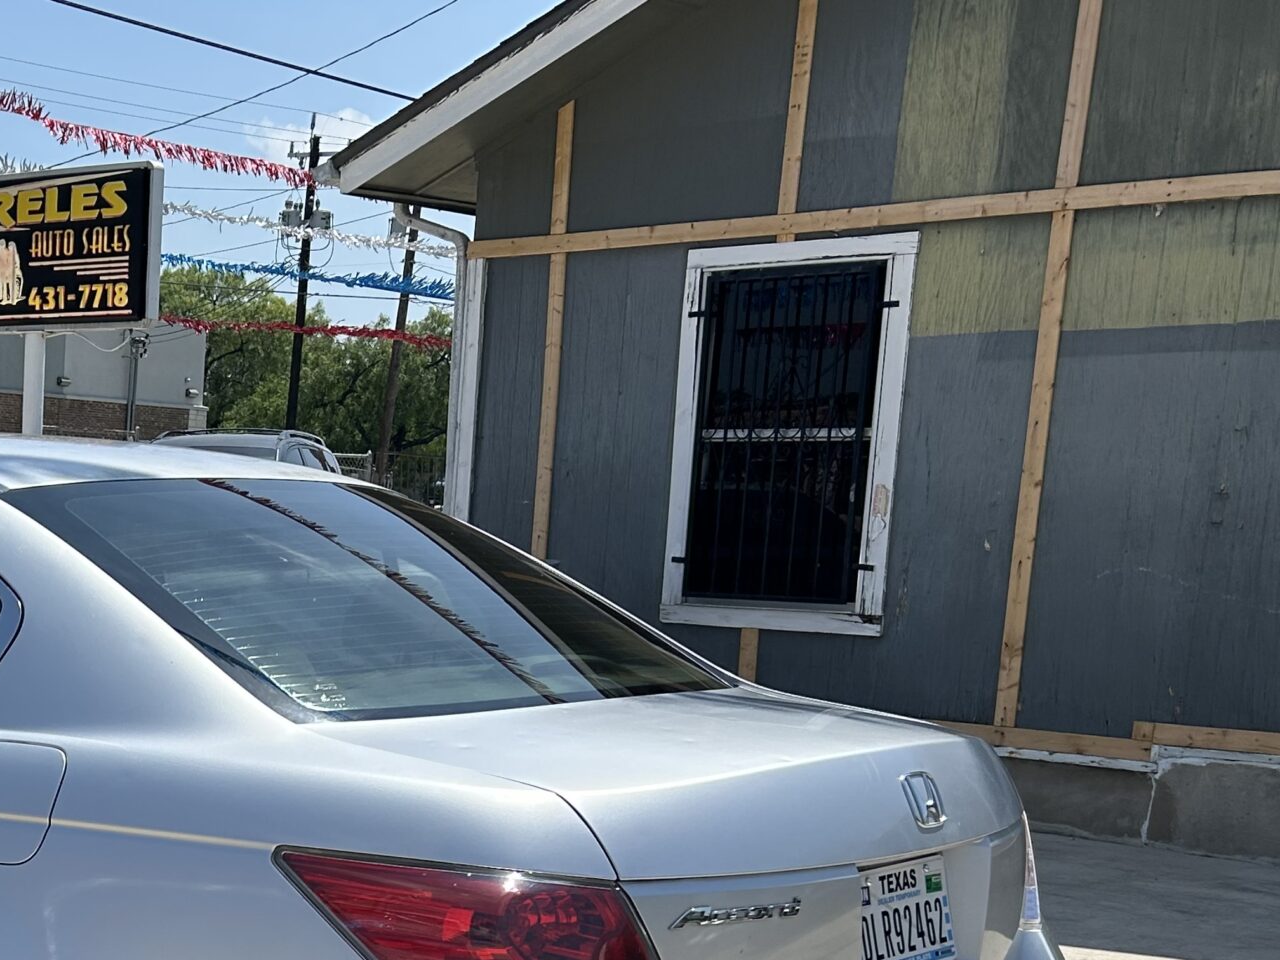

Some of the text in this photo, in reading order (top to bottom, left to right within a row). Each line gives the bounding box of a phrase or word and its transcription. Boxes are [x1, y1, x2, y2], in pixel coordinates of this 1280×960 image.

[29, 224, 131, 258] AUTO SALES
[28, 282, 129, 311] 431-7718
[878, 868, 918, 895] TEXAS
[668, 896, 802, 930] Accord
